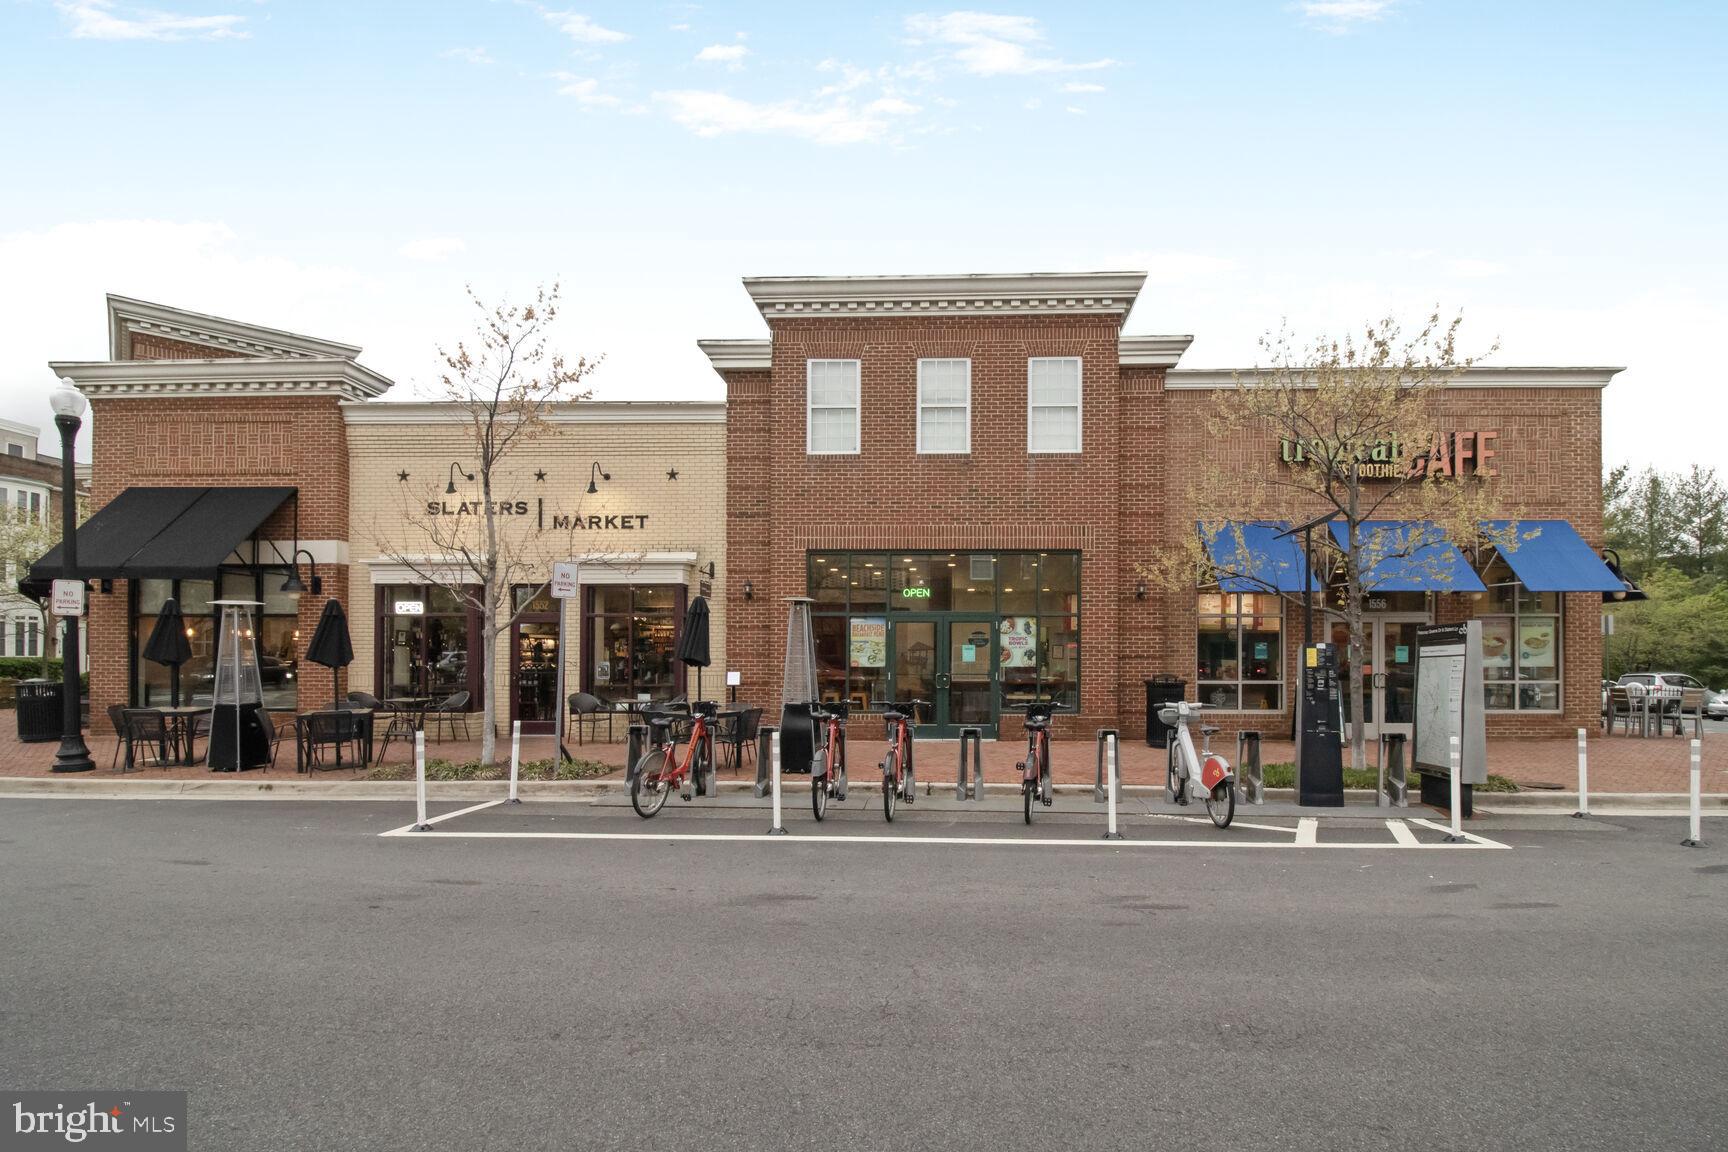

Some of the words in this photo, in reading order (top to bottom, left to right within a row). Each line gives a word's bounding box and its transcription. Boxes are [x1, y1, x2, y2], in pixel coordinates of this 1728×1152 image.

[1342, 463, 1401, 477] SOOTHIE
[427, 501, 529, 516] SLATERS
[553, 514, 649, 529] MARKET
[903, 588, 930, 597] OPEN
[56, 598, 80, 606] PARKING
[1368, 598, 1387, 609] 1556
[397, 603, 421, 612] OPEN
